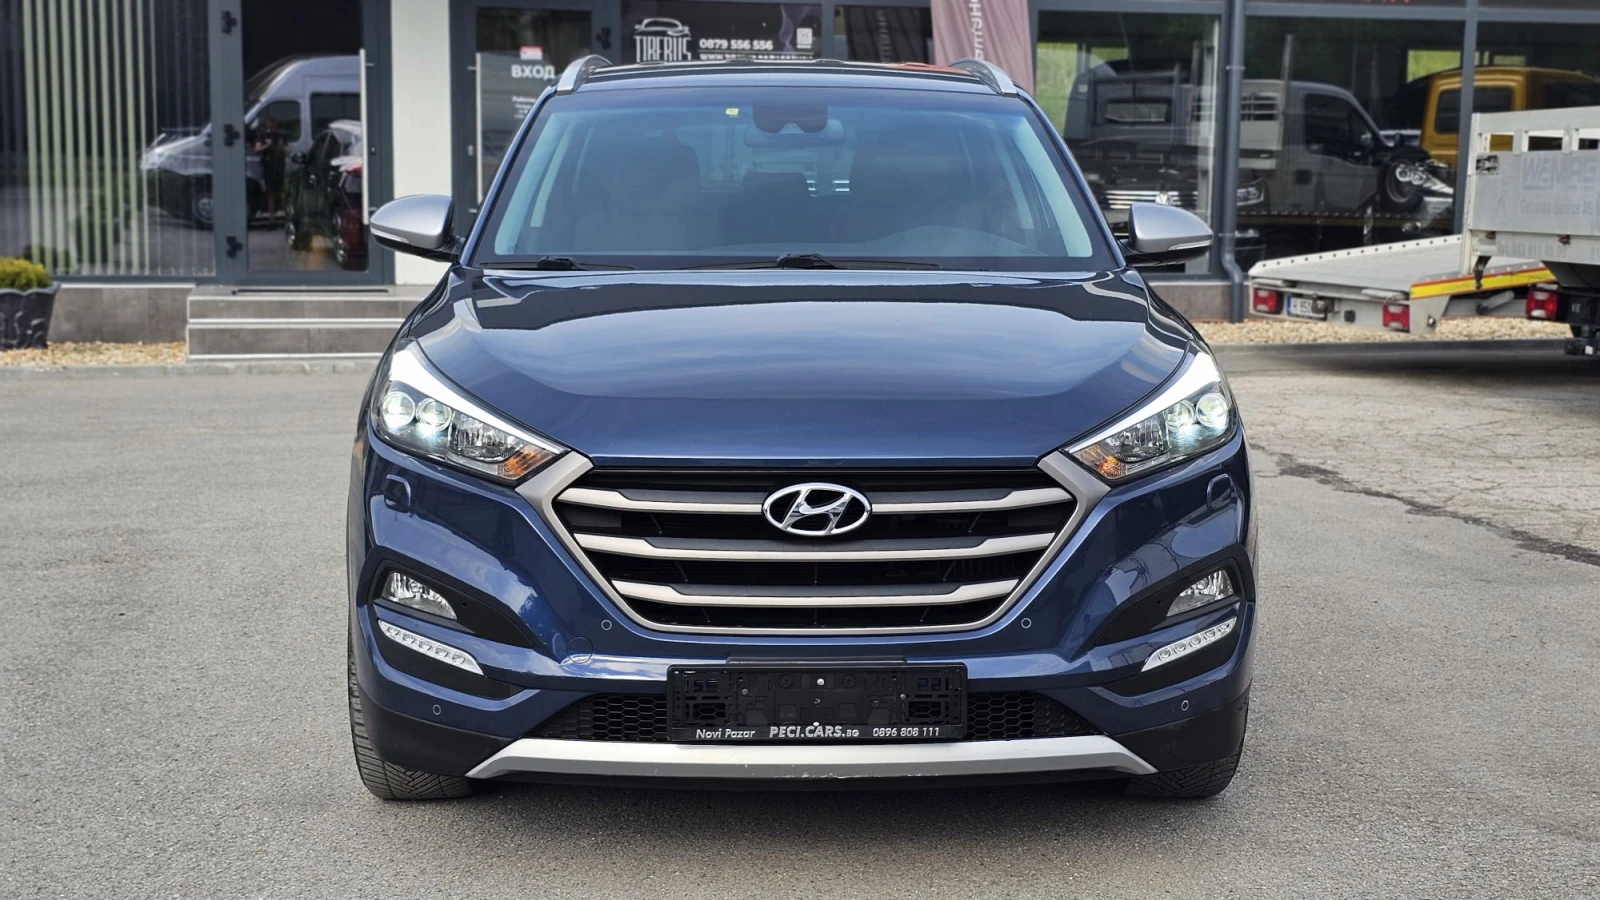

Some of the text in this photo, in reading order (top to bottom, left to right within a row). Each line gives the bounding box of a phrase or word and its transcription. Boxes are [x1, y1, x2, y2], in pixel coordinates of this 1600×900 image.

[699, 39, 773, 50] 0879 556 556
[511, 64, 555, 80] ВХОД
[696, 729, 722, 738] Novi
[724, 729, 756, 738] Pazar
[872, 728, 897, 737] 0896
[900, 728, 919, 737] 808
[921, 727, 940, 737] 111
